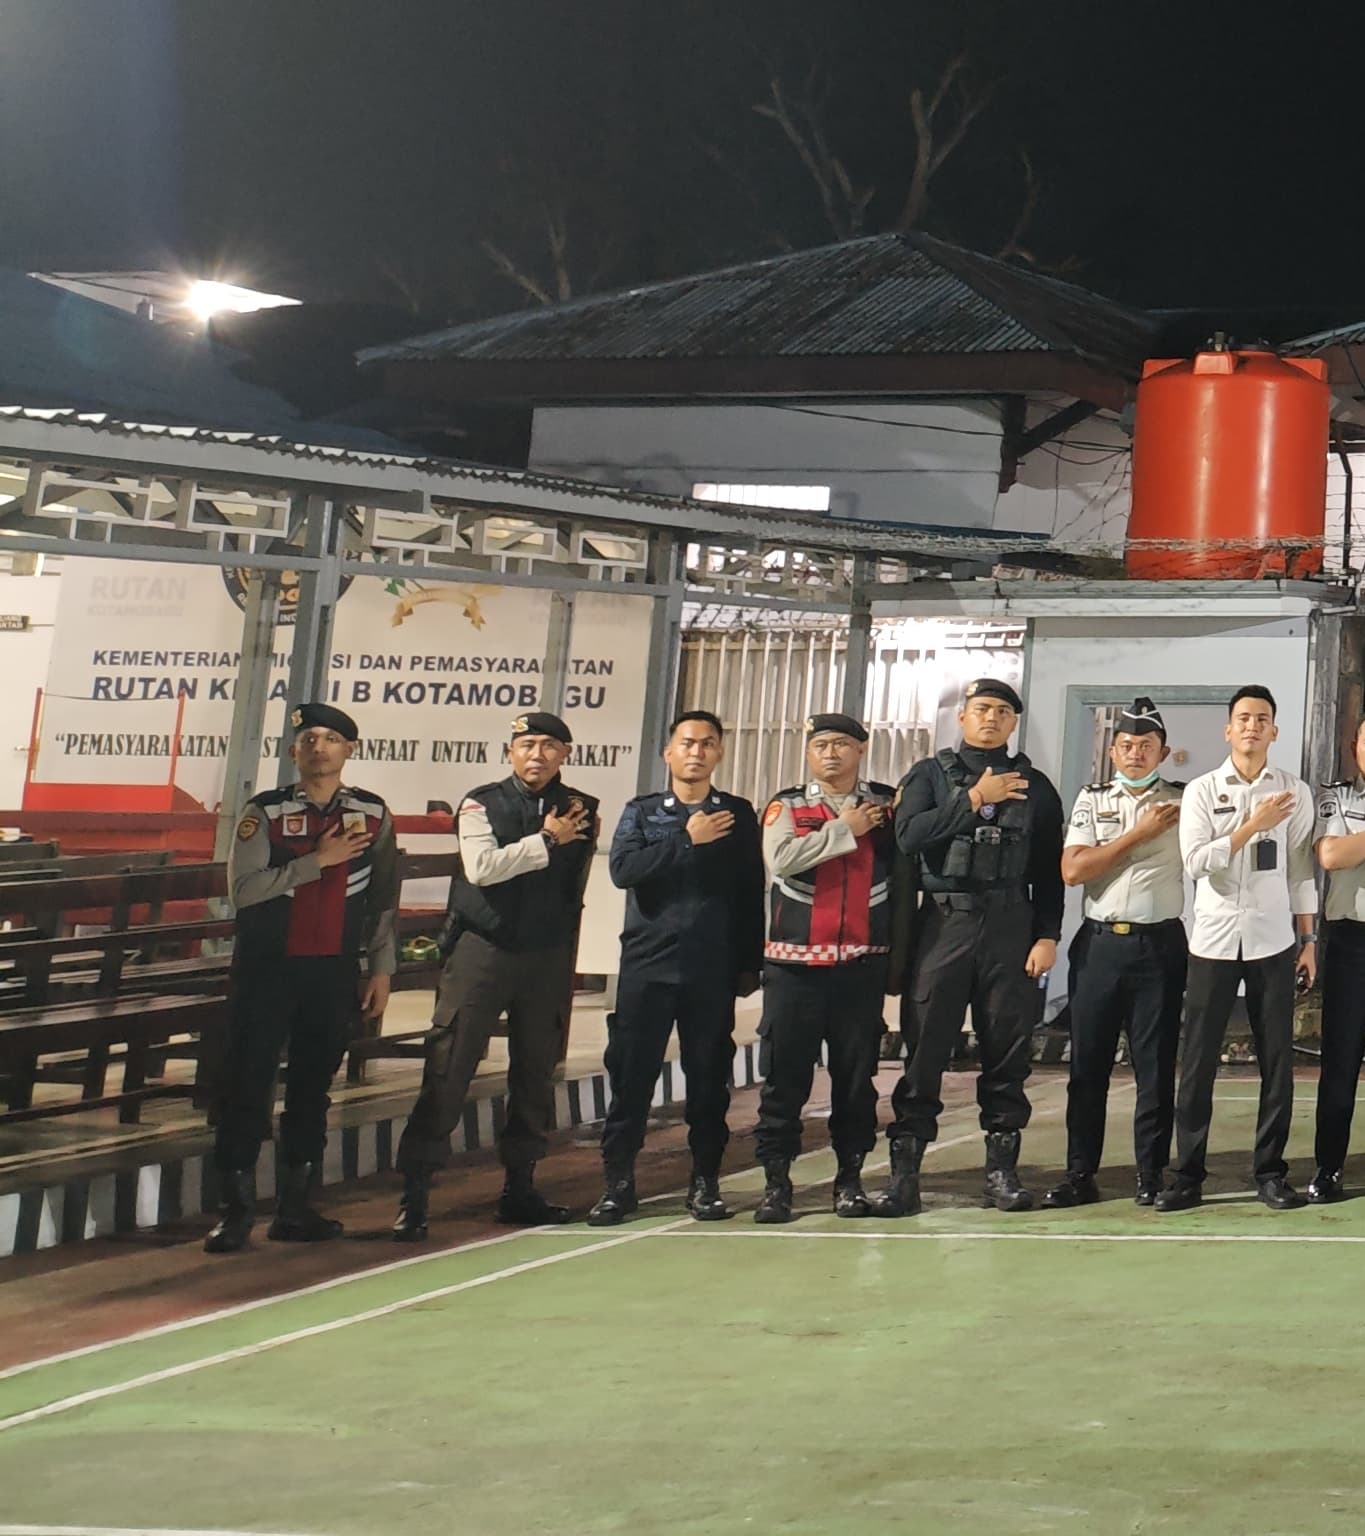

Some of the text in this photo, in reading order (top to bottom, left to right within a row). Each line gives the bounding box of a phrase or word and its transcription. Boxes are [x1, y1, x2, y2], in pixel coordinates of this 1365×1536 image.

[359, 654, 403, 671] DAN
[409, 655, 614, 676] PEMASYARATAN
[92, 676, 199, 701] RUTAN
[351, 681, 372, 703] B
[382, 681, 607, 709] KOTAMOBGU
[431, 740, 490, 764] UNTUK
